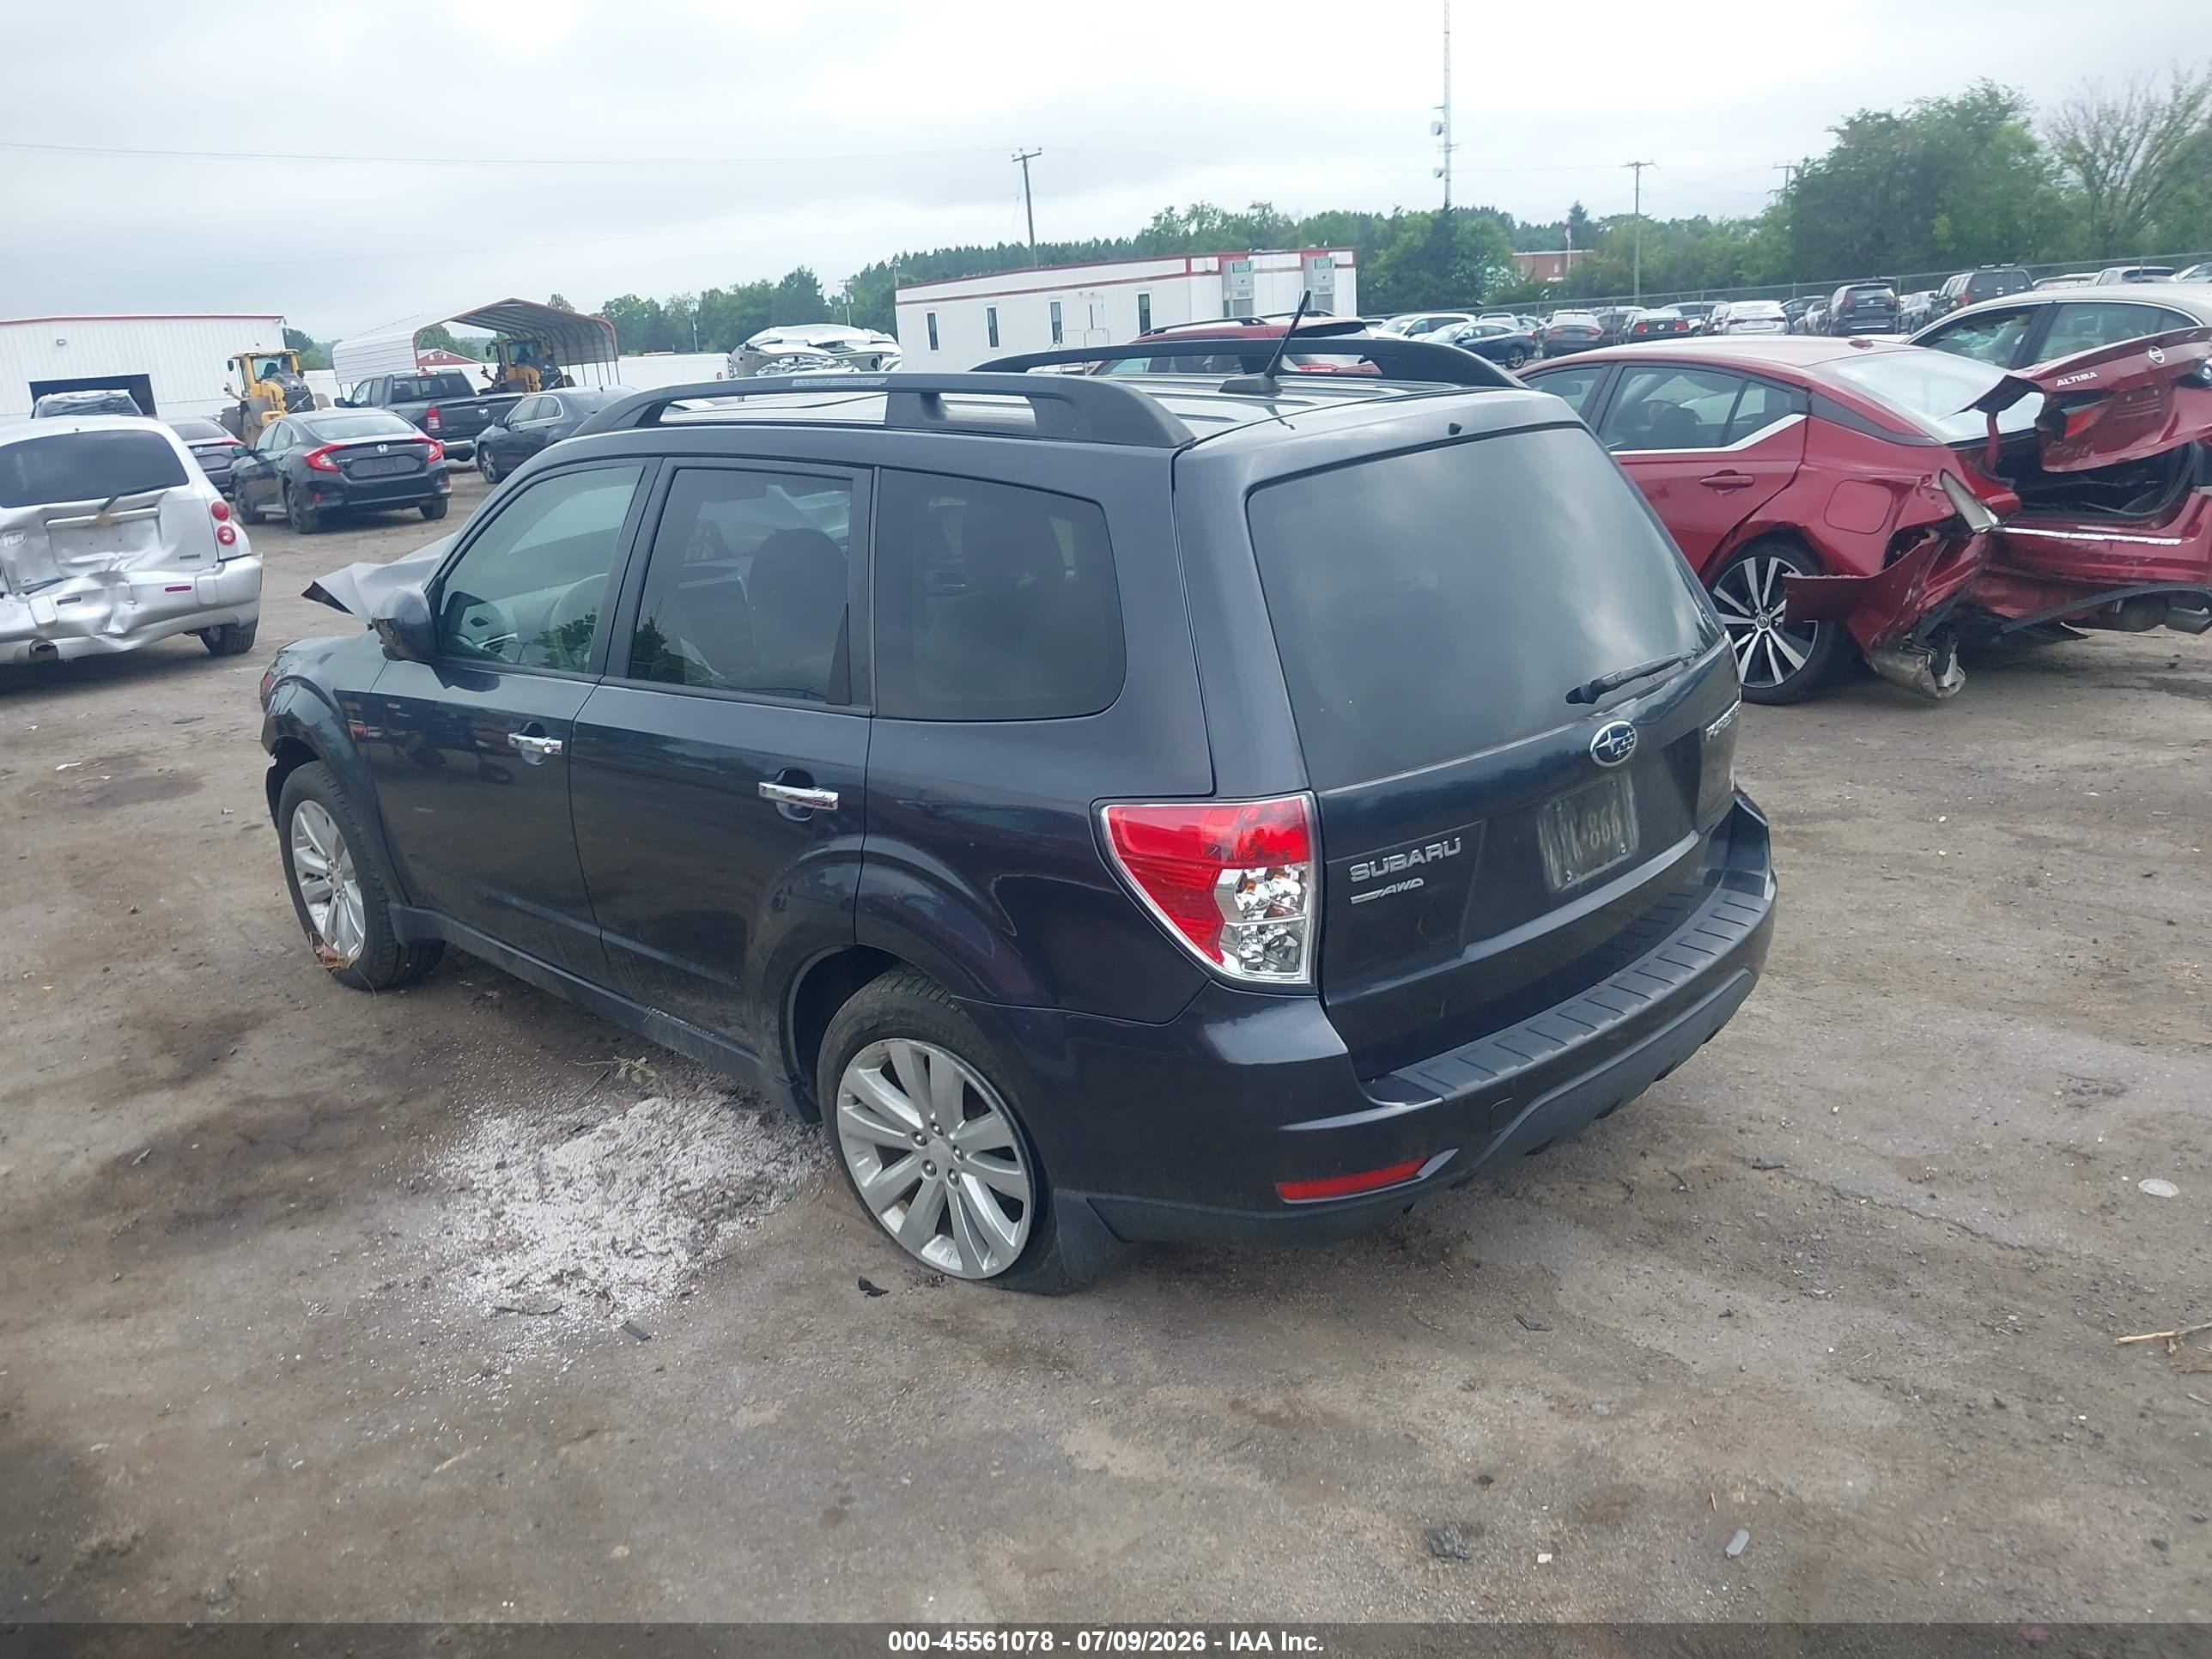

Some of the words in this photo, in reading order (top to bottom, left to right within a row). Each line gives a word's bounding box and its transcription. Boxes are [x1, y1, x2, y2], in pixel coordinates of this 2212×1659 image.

[2056, 371, 2099, 387] ALTIMA
[1349, 836, 1462, 883] SUBARU
[1379, 877, 1425, 898] AWD
